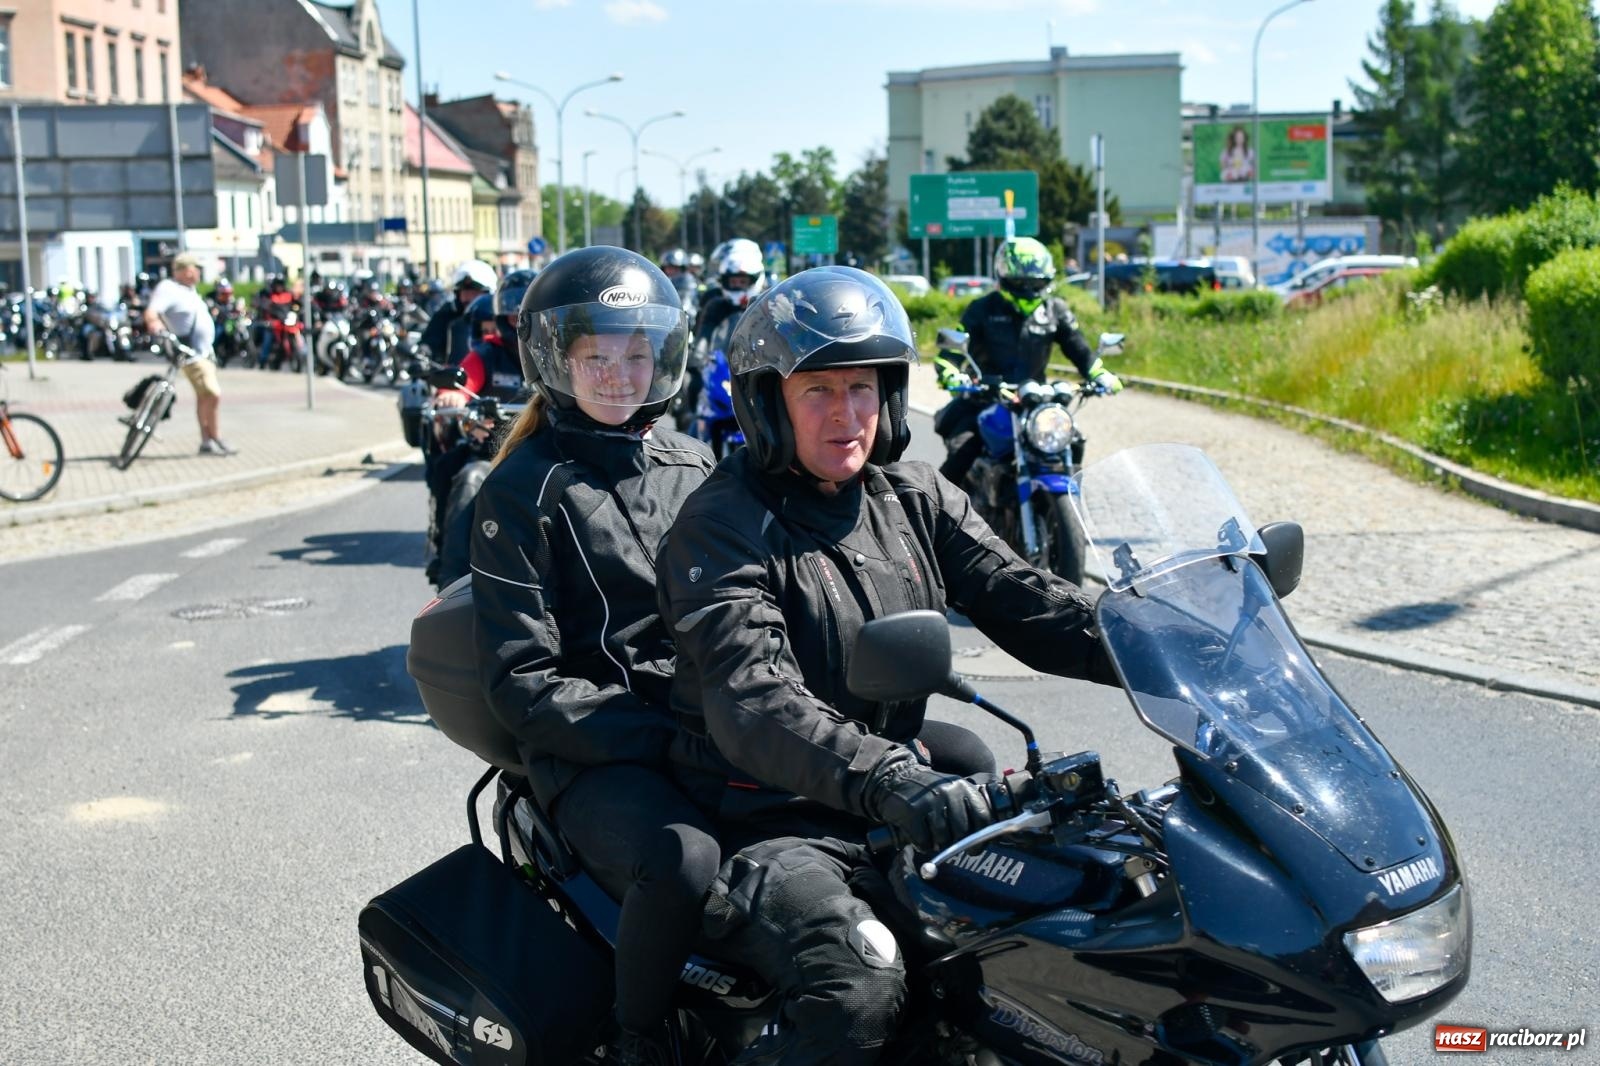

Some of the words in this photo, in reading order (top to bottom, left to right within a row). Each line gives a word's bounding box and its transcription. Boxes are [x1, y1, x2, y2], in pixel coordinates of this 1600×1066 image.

[945, 849, 1025, 886] AMAHA
[1377, 856, 1440, 896] YAMAHA
[989, 1001, 1104, 1066] Diversion
